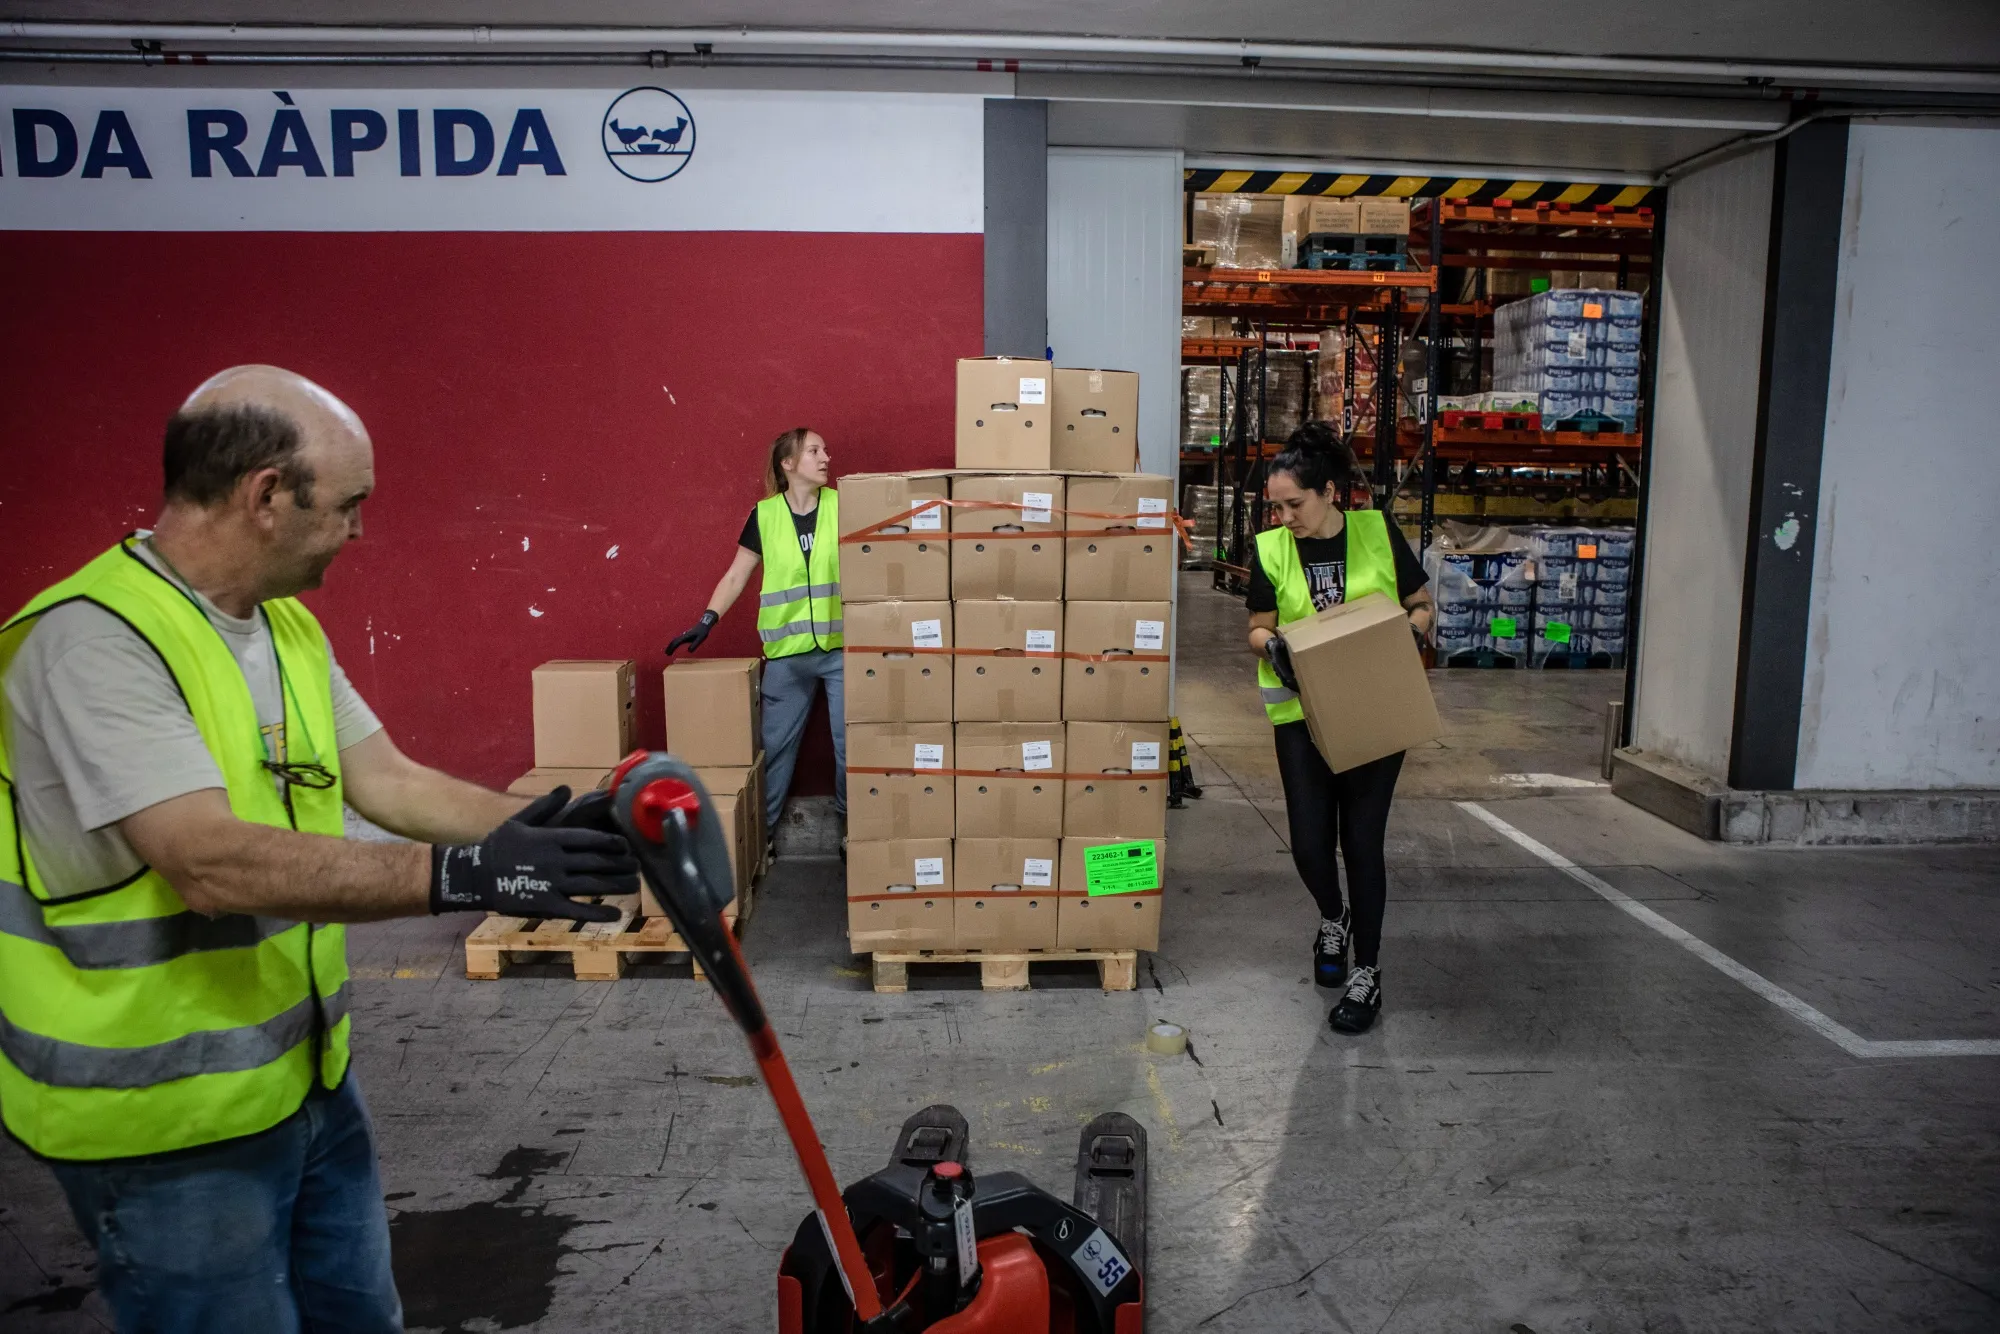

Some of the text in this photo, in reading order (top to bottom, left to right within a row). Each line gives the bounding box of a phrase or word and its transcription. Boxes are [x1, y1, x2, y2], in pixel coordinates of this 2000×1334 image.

[0, 91, 567, 179] DA RÀPIDA
[1345, 408, 1351, 430] B
[1419, 396, 1426, 422] A
[1312, 565, 1337, 591] THE
[497, 875, 549, 895] HyFlex
[1098, 1256, 1125, 1287] 55
